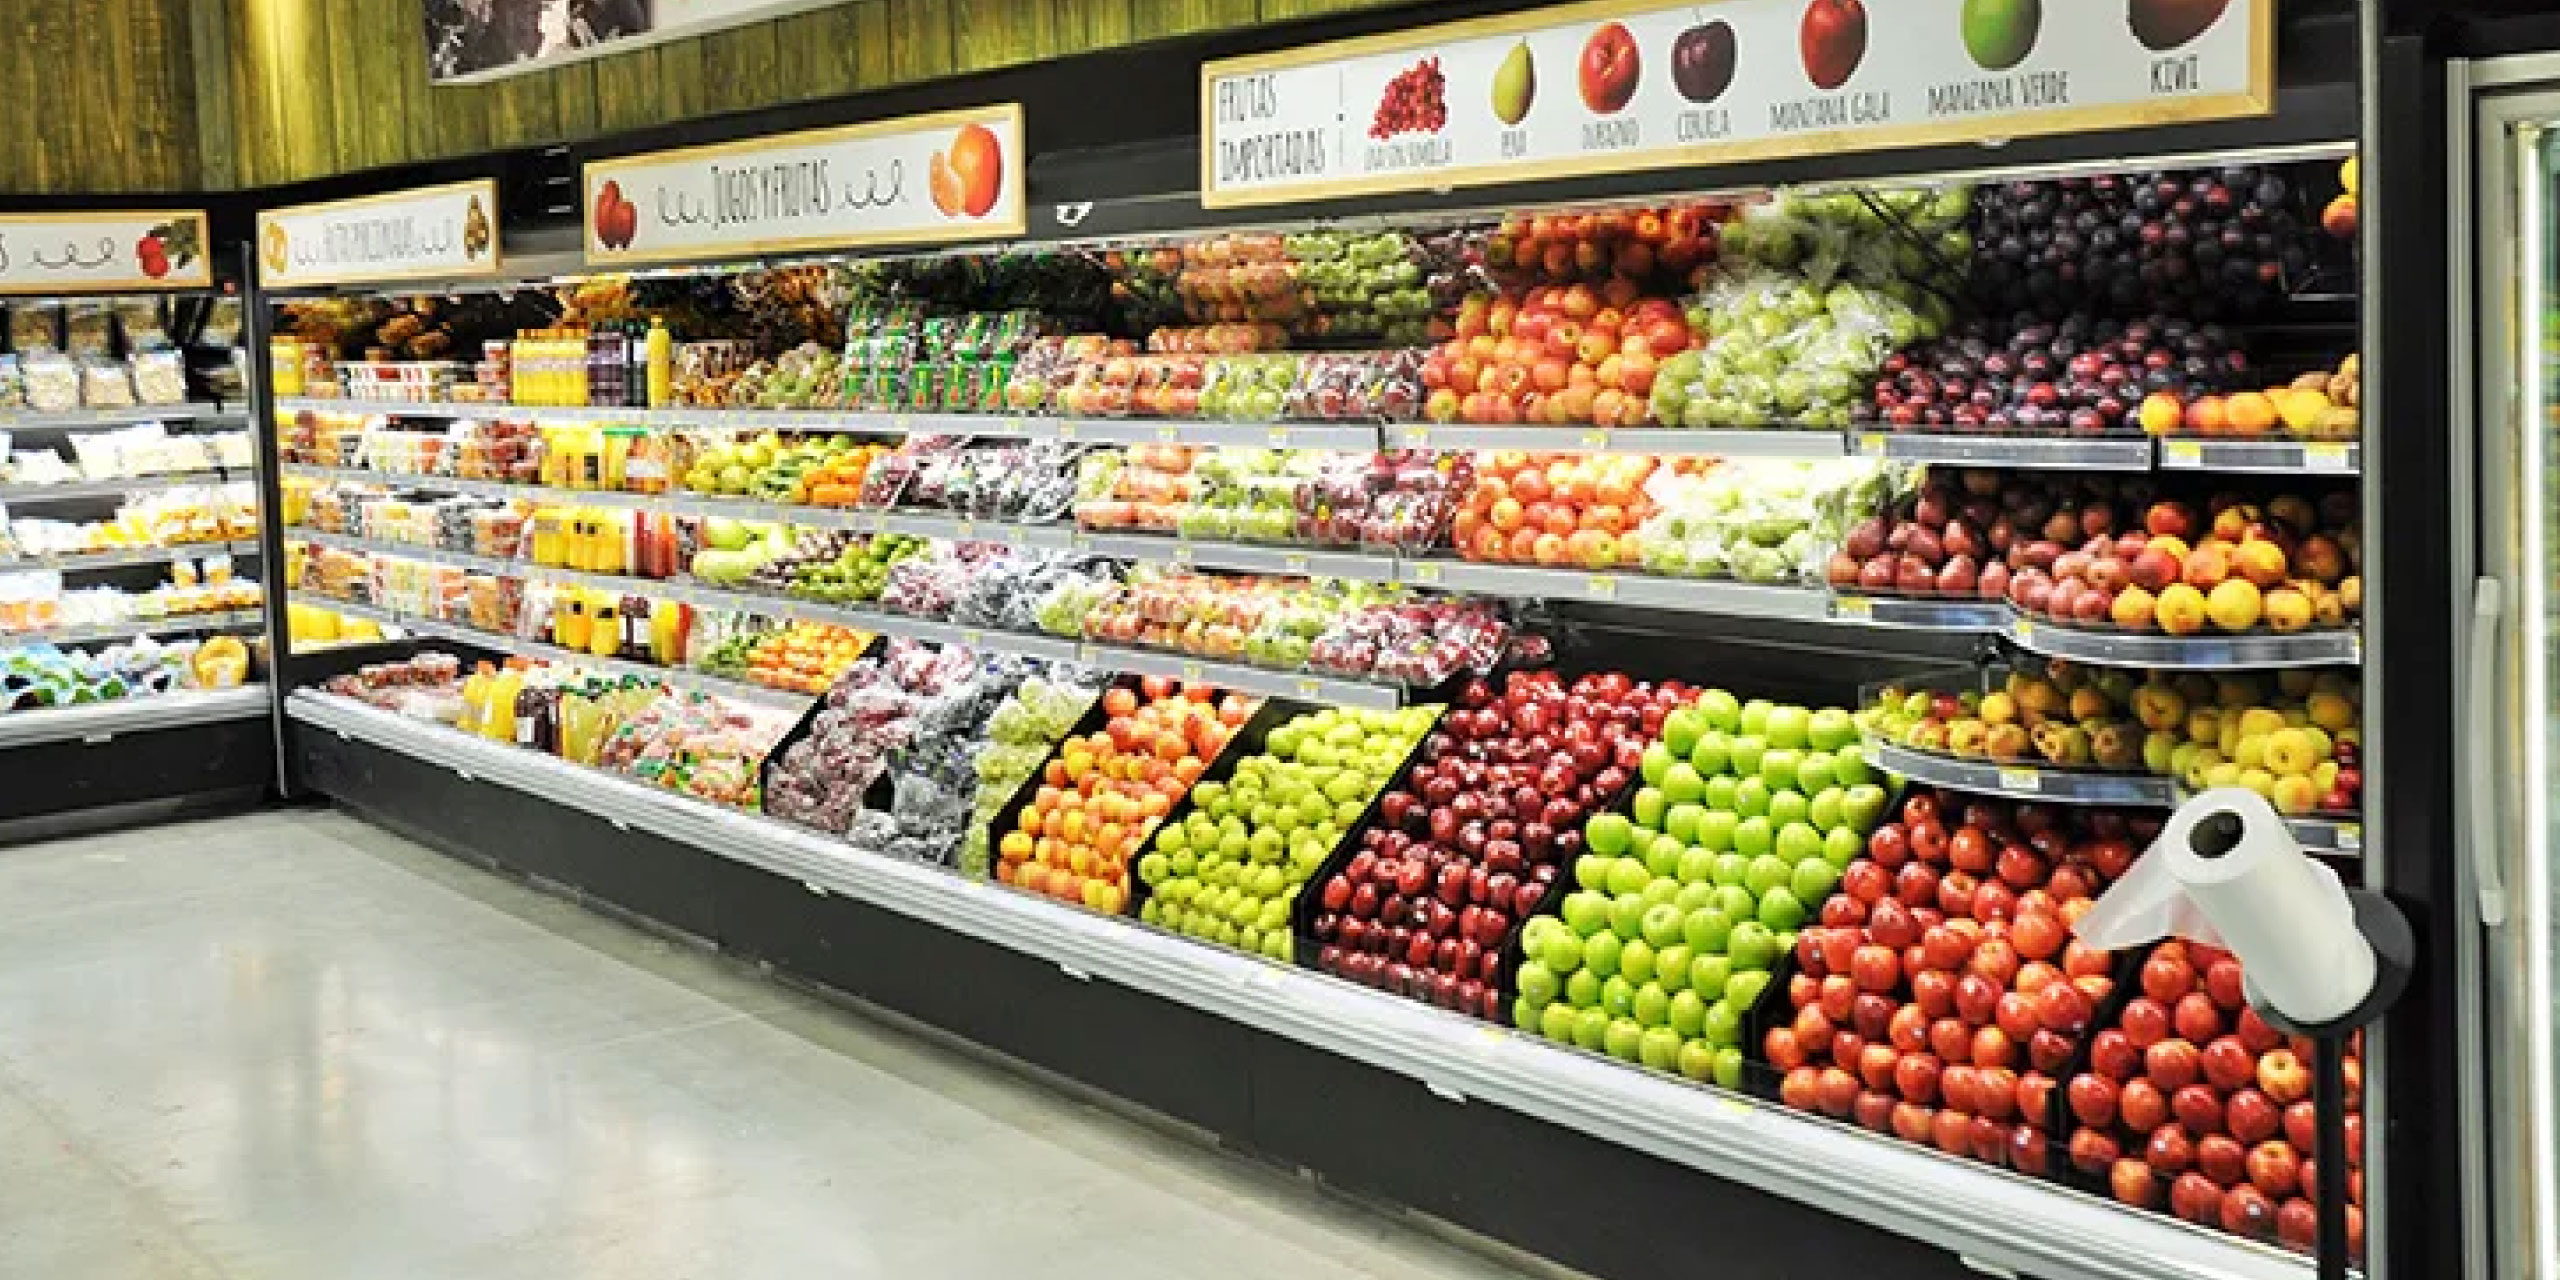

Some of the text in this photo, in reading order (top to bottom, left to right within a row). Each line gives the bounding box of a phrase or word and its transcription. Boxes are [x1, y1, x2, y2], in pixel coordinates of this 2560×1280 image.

[1928, 71, 2069, 114] MANZANA VERDE
[2150, 54, 2198, 93] KIWI
[1219, 75, 1276, 122] FRUTAS
[1219, 128, 1325, 181] IMPORTADAS
[711, 166, 757, 230] JUGOS
[774, 160, 831, 216] FRUTAS
